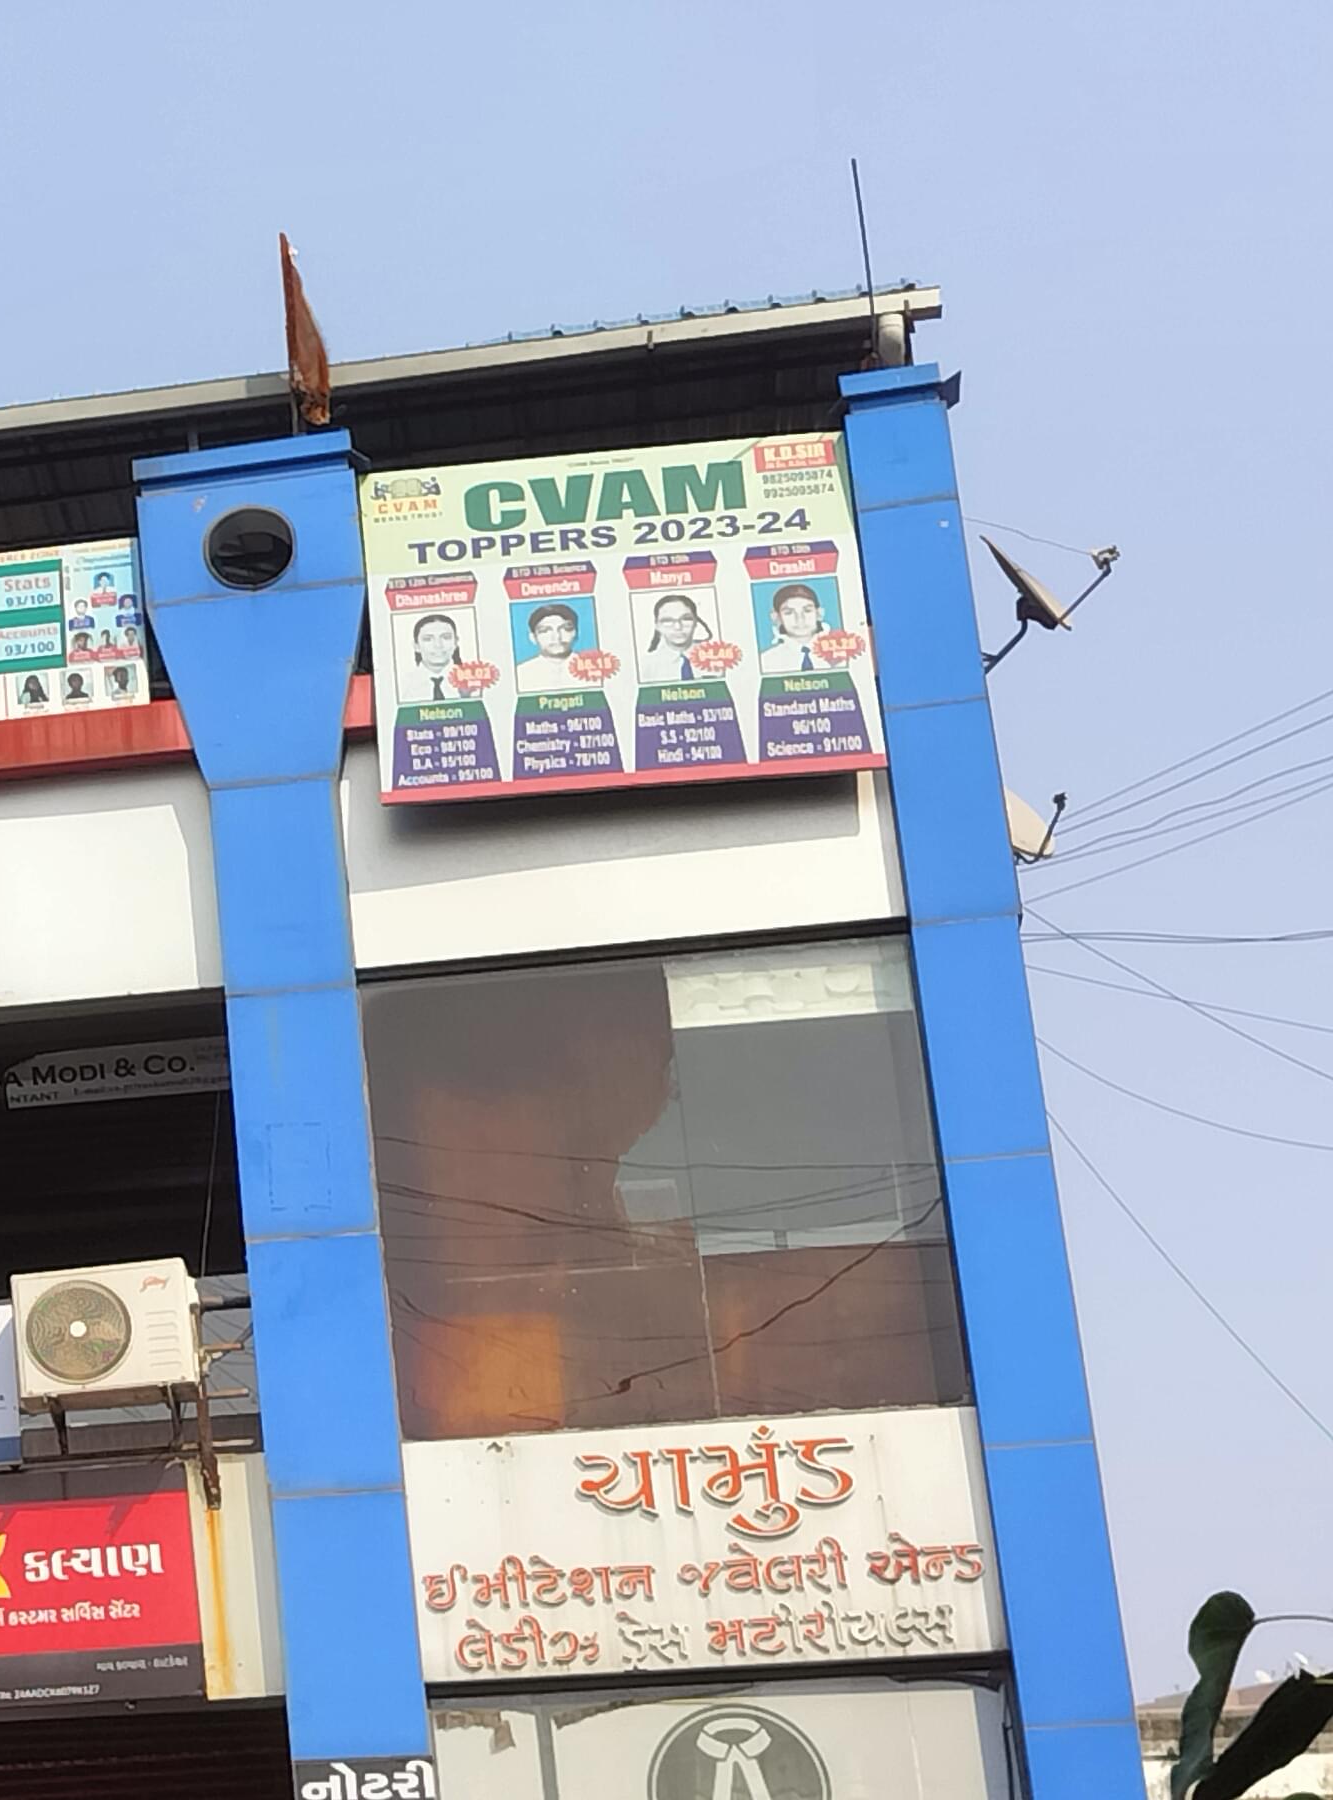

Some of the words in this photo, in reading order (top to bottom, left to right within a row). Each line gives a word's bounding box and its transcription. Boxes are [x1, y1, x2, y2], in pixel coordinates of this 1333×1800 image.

[464, 460, 747, 532] CVAM
[378, 499, 438, 515] CVAM
[407, 525, 617, 564] TOPPERS
[634, 508, 811, 545] 2023-24
[4, 576, 51, 593] Stats
[521, 579, 580, 596] Devendra
[650, 571, 691, 587] Manya
[395, 591, 468, 608] Dhanashree
[784, 679, 829, 692] Nelson
[538, 695, 583, 712] Pragati
[661, 688, 706, 702] Nelson
[419, 708, 463, 721] Nelson
[23, 1542, 166, 1582] કલ્યાણ
